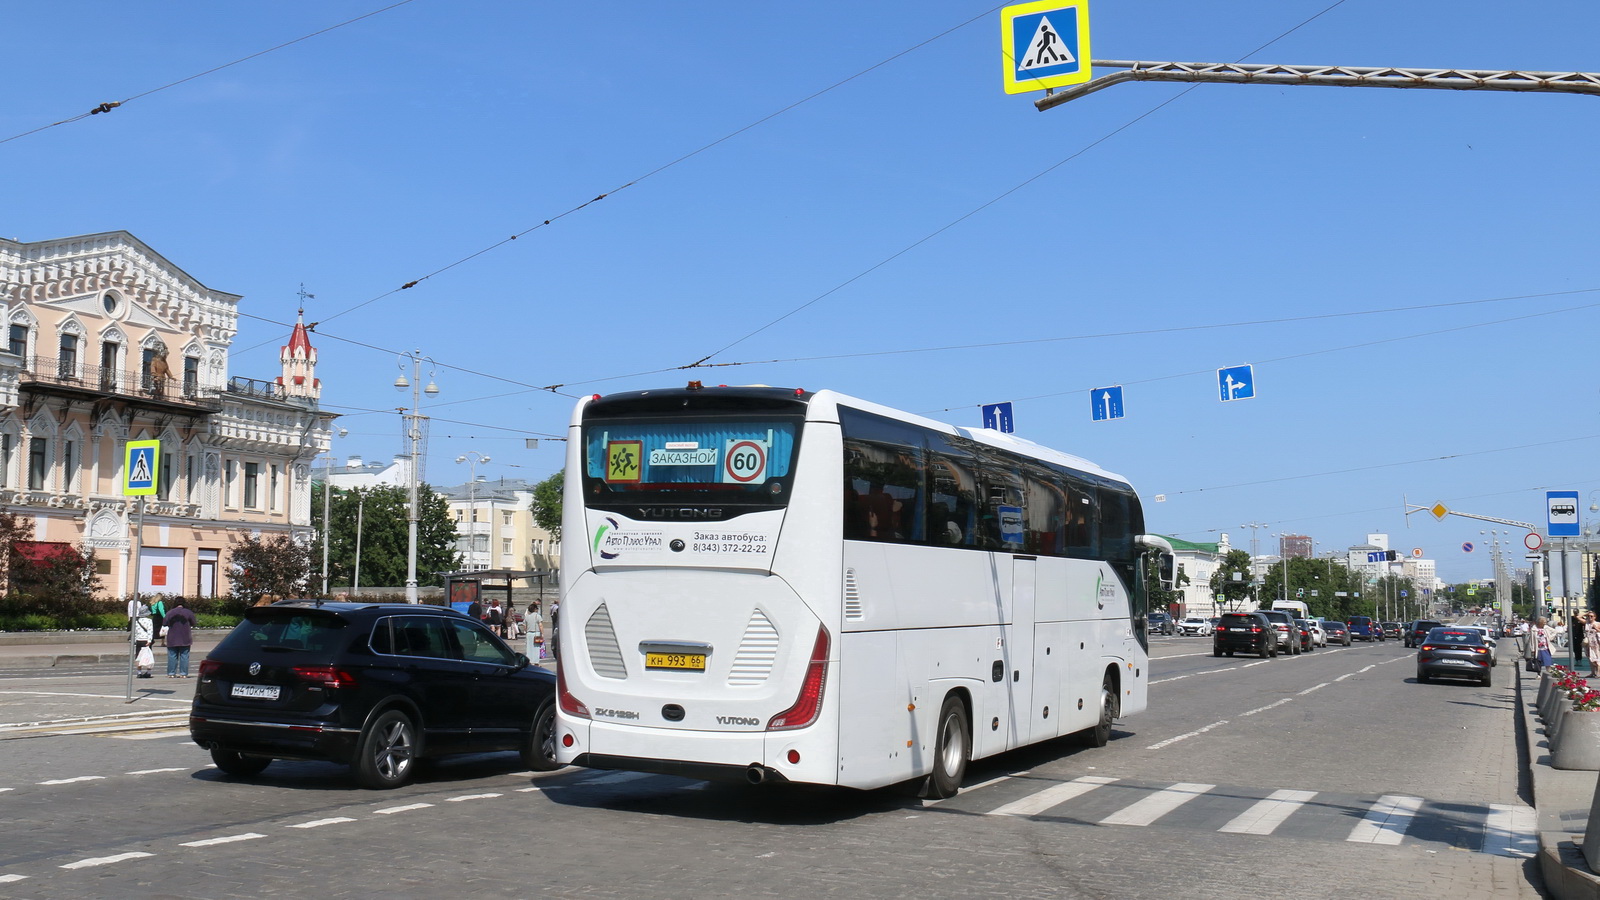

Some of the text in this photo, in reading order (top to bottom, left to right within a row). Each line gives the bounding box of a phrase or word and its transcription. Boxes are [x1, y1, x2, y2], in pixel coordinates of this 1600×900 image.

[652, 452, 716, 465] ЗАКАЗНОЙ
[733, 453, 757, 471] 60
[639, 508, 722, 517] YUTONG
[694, 531, 767, 544] Заказ автобуса:
[692, 543, 767, 554] 8(343) 372-22-22
[667, 655, 686, 667] 993
[690, 655, 701, 664] 66
